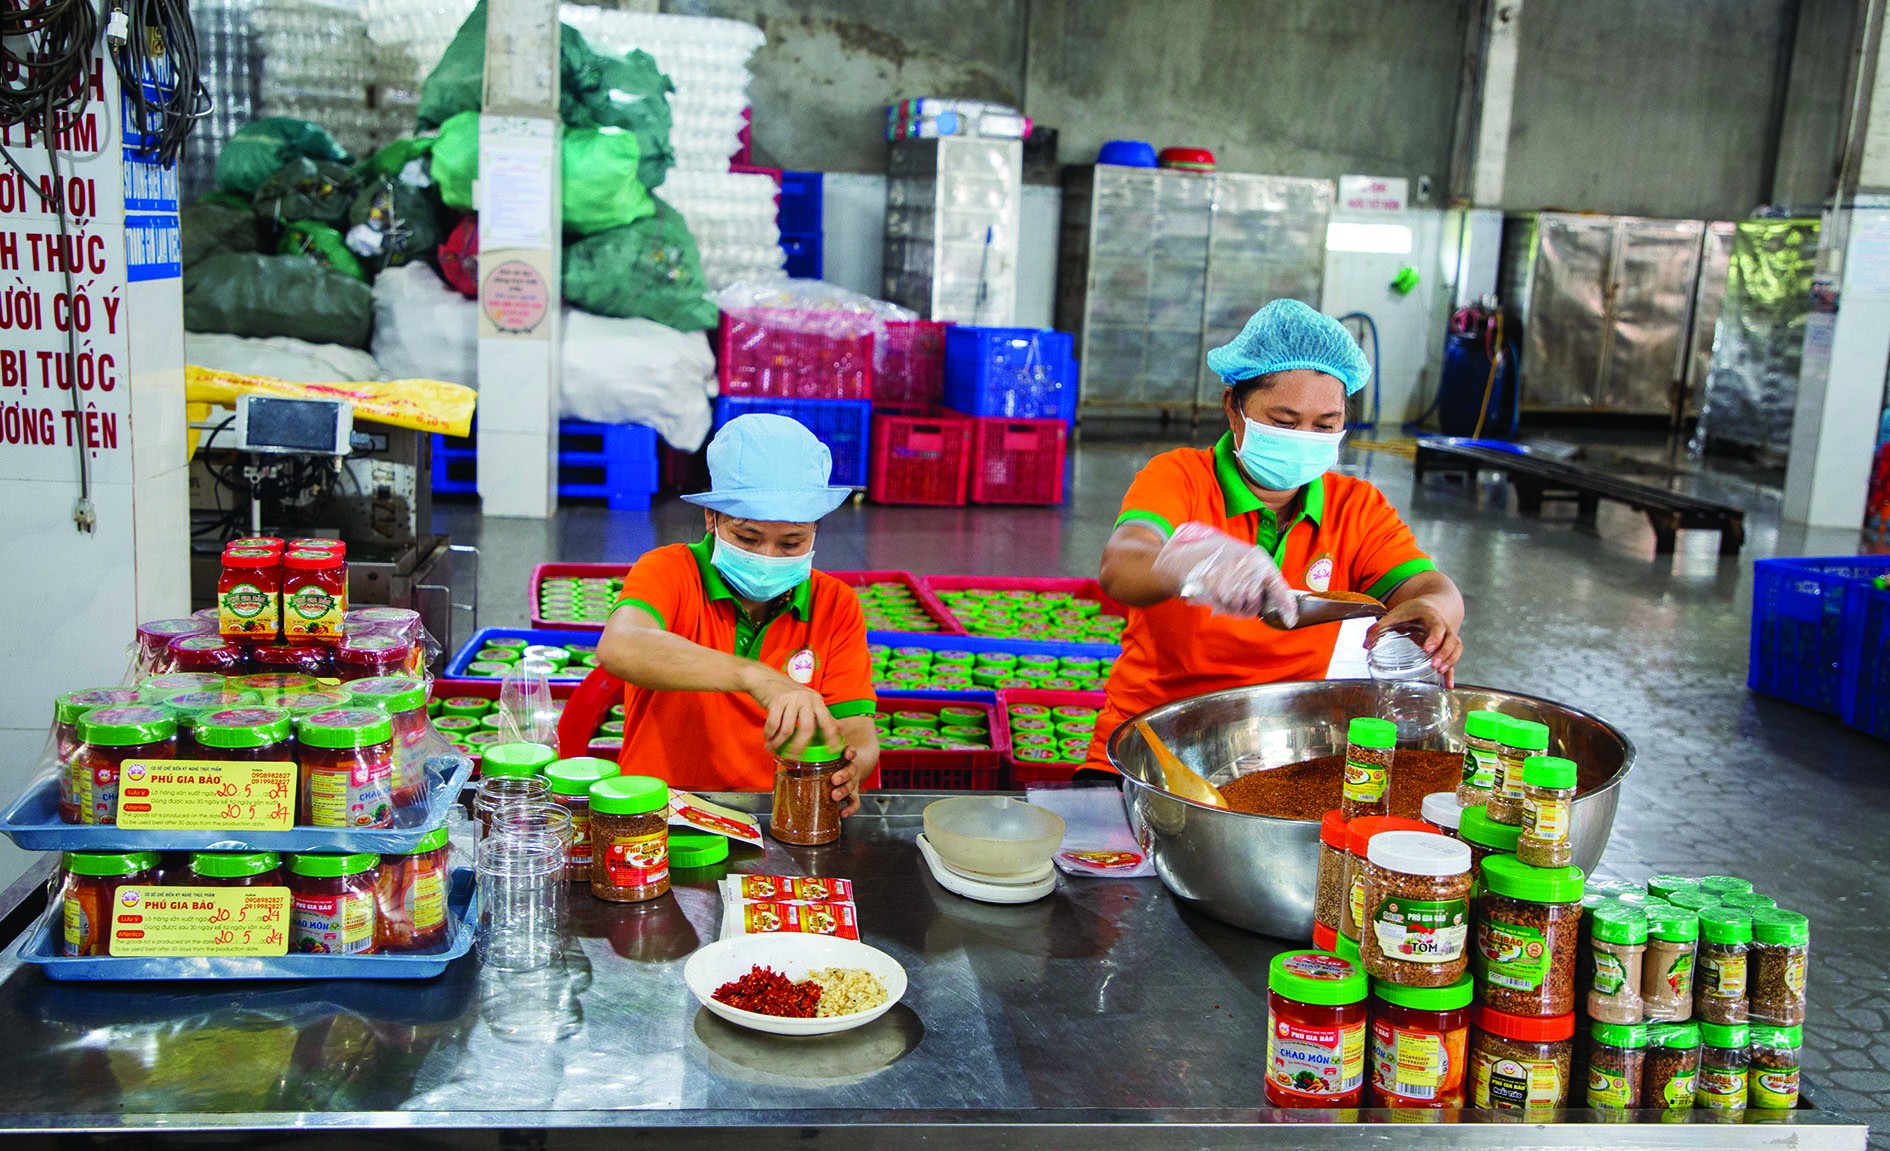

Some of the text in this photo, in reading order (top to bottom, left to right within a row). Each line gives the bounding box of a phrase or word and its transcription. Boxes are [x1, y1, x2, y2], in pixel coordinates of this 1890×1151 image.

[40, 174, 96, 225] MỌI
[26, 219, 106, 274] THỨC
[53, 279, 95, 333] CỐ
[103, 286, 120, 334] Ý
[0, 350, 28, 396] BỊ
[62, 402, 118, 458] TIỆN
[151, 773, 221, 784] PHÚ GIA BẢO
[144, 900, 214, 910] PHÚ GIA BẢO
[310, 921, 329, 930] MÔN
[1503, 935, 1523, 946] BẢO
[1291, 1031, 1334, 1042] PHÚ GIA BẢO
[1280, 1048, 1330, 1064] CHAO MÔN
